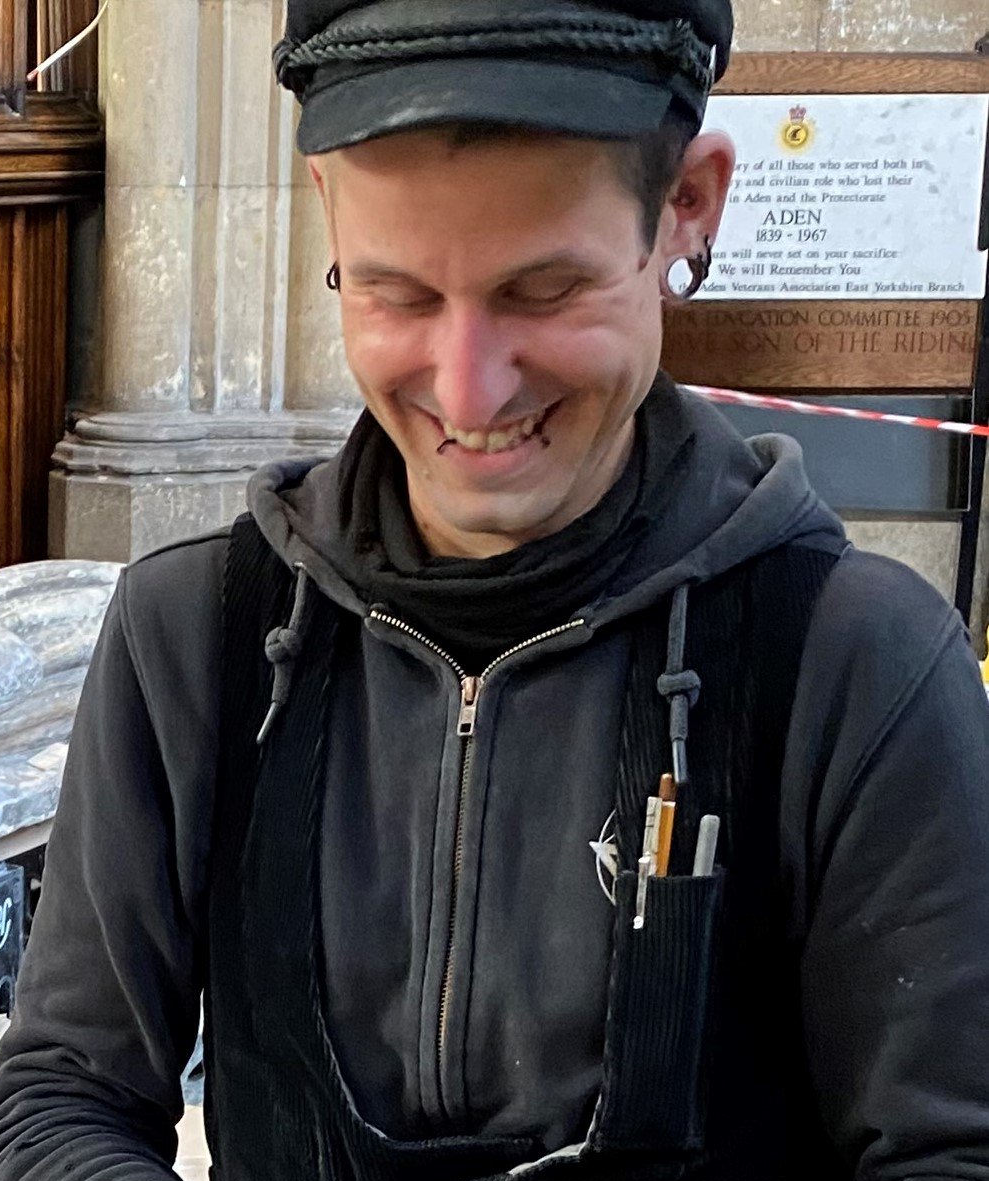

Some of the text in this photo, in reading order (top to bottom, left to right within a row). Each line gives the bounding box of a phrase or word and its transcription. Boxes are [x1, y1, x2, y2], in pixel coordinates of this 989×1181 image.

[753, 160, 764, 170] of
[769, 160, 782, 170] all
[787, 160, 815, 170] those
[819, 160, 840, 170] who
[844, 159, 878, 170] served
[883, 159, 907, 170] both
[745, 176, 765, 187] and
[769, 176, 809, 186] civilian
[814, 176, 833, 186] role
[838, 175, 860, 186] who
[864, 175, 883, 185] lost
[888, 175, 913, 185] their
[745, 192, 771, 203] Aden
[776, 192, 796, 203] and
[801, 192, 816, 203] the
[822, 192, 886, 203] Protectorate
[763, 208, 822, 225] ADEN
[756, 229, 782, 242] 1839
[798, 229, 827, 242] 1967
[711, 249, 898, 261] un will never set on your sacrifice
[718, 263, 861, 275] We will Remember You
[732, 282, 775, 292] Veterans
[780, 282, 840, 292] Association
[846, 282, 868, 292] East
[874, 282, 923, 294] Yorkshire
[928, 282, 964, 292] Branch
[818, 309, 919, 327] COMMITTEE
[794, 331, 821, 353] OF
[836, 331, 882, 353] THE
